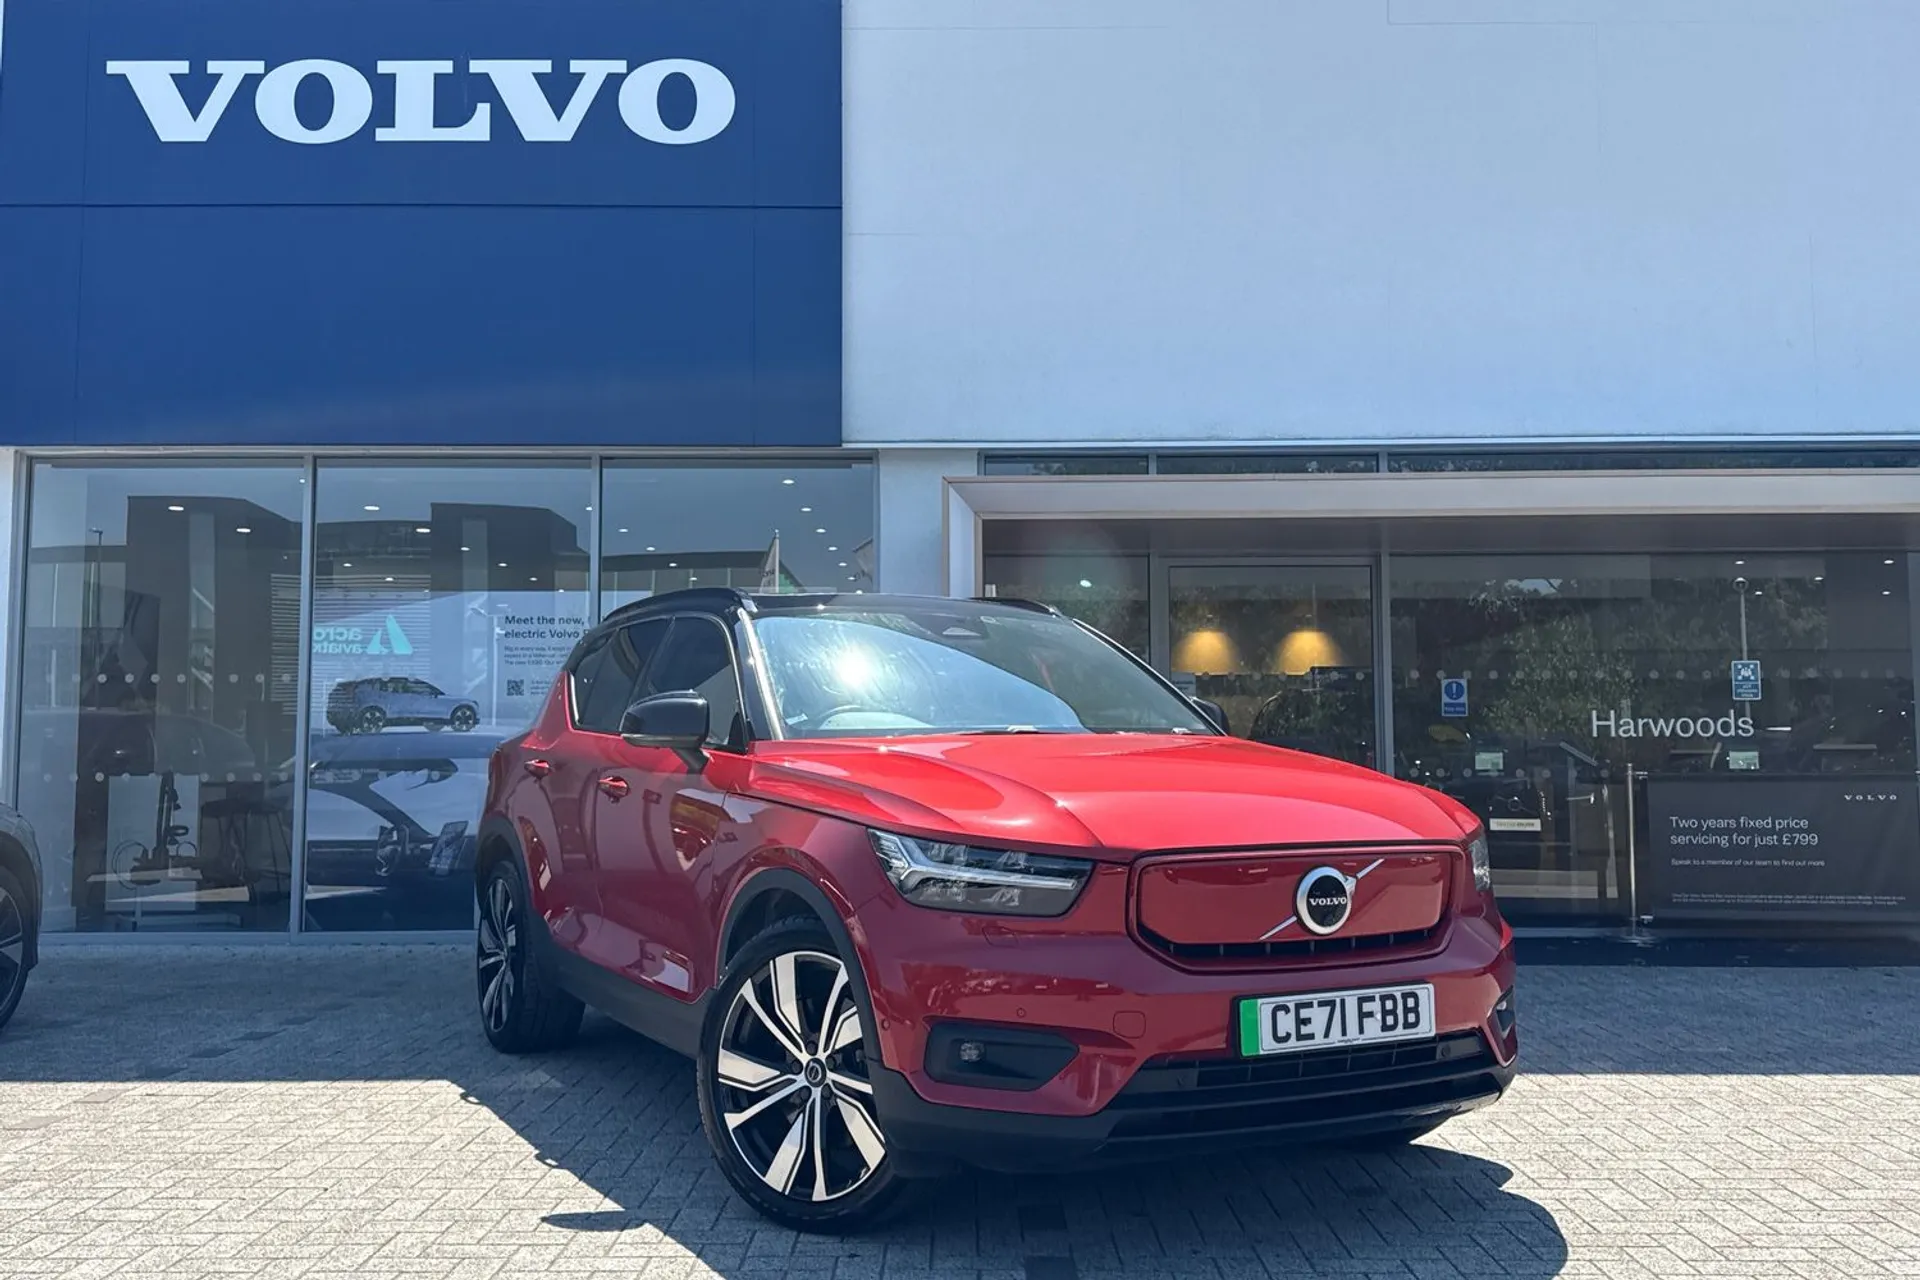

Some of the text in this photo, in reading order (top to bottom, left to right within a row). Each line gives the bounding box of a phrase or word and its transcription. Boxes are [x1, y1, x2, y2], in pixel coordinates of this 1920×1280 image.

[106, 58, 735, 145] VOLVO
[504, 615, 584, 627] Meet the new,
[504, 629, 547, 639] electric
[549, 629, 580, 639] Volvo
[1592, 709, 1755, 738] Harwoods
[1669, 816, 1809, 832] Two years fixed price
[1670, 832, 1819, 848] servicing for just £799
[1734, 858, 1742, 866] of
[1781, 858, 1795, 867] find
[1795, 859, 1806, 867] out
[1309, 896, 1348, 906] VOLVO
[1271, 990, 1421, 1044] CE71 FBB
